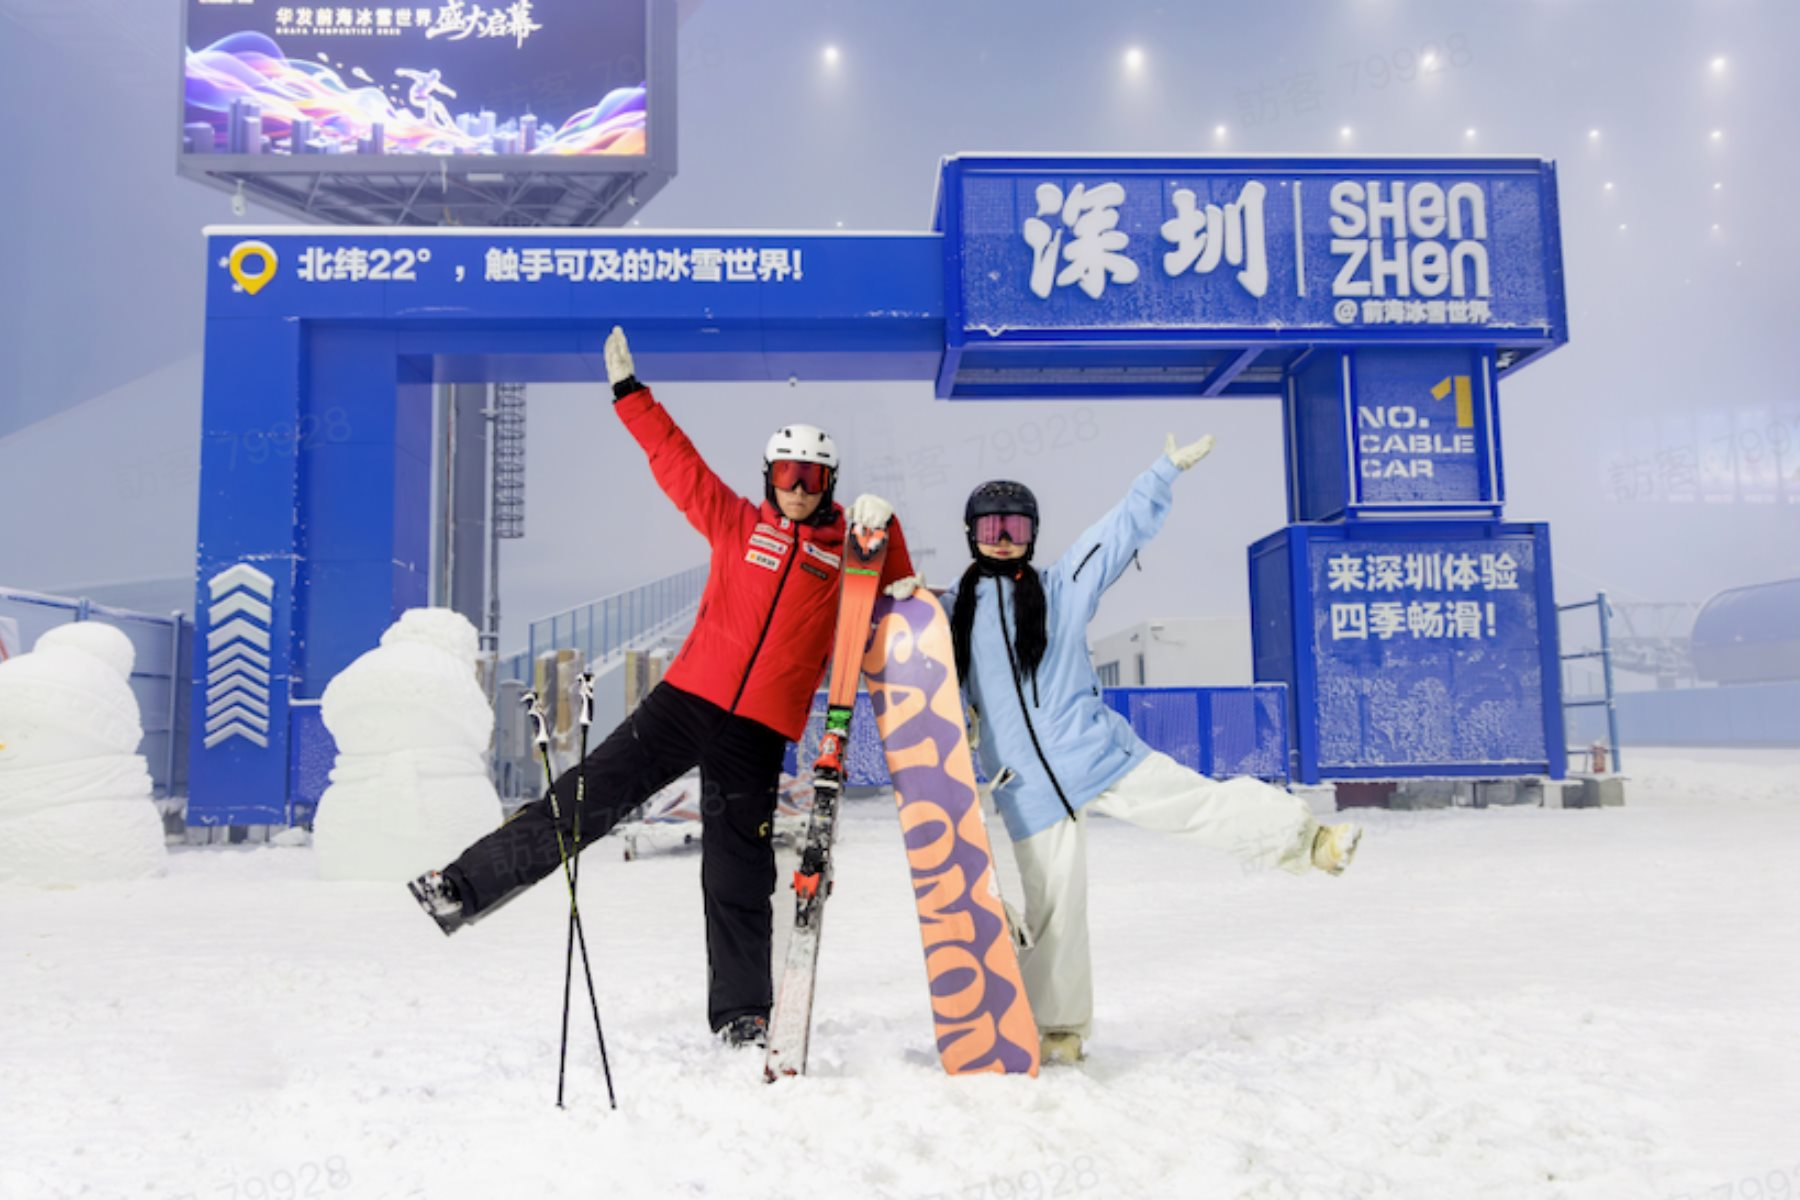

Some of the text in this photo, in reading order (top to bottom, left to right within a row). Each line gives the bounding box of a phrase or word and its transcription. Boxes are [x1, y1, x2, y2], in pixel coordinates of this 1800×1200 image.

[425, 0, 544, 49] 盛大启幕
[1023, 181, 1268, 298] 深圳
[1358, 375, 1475, 429] NO. 1
[1358, 434, 1476, 454] CABLE
[1359, 458, 1435, 479] CAR
[1327, 552, 1520, 592] 来深圳体验
